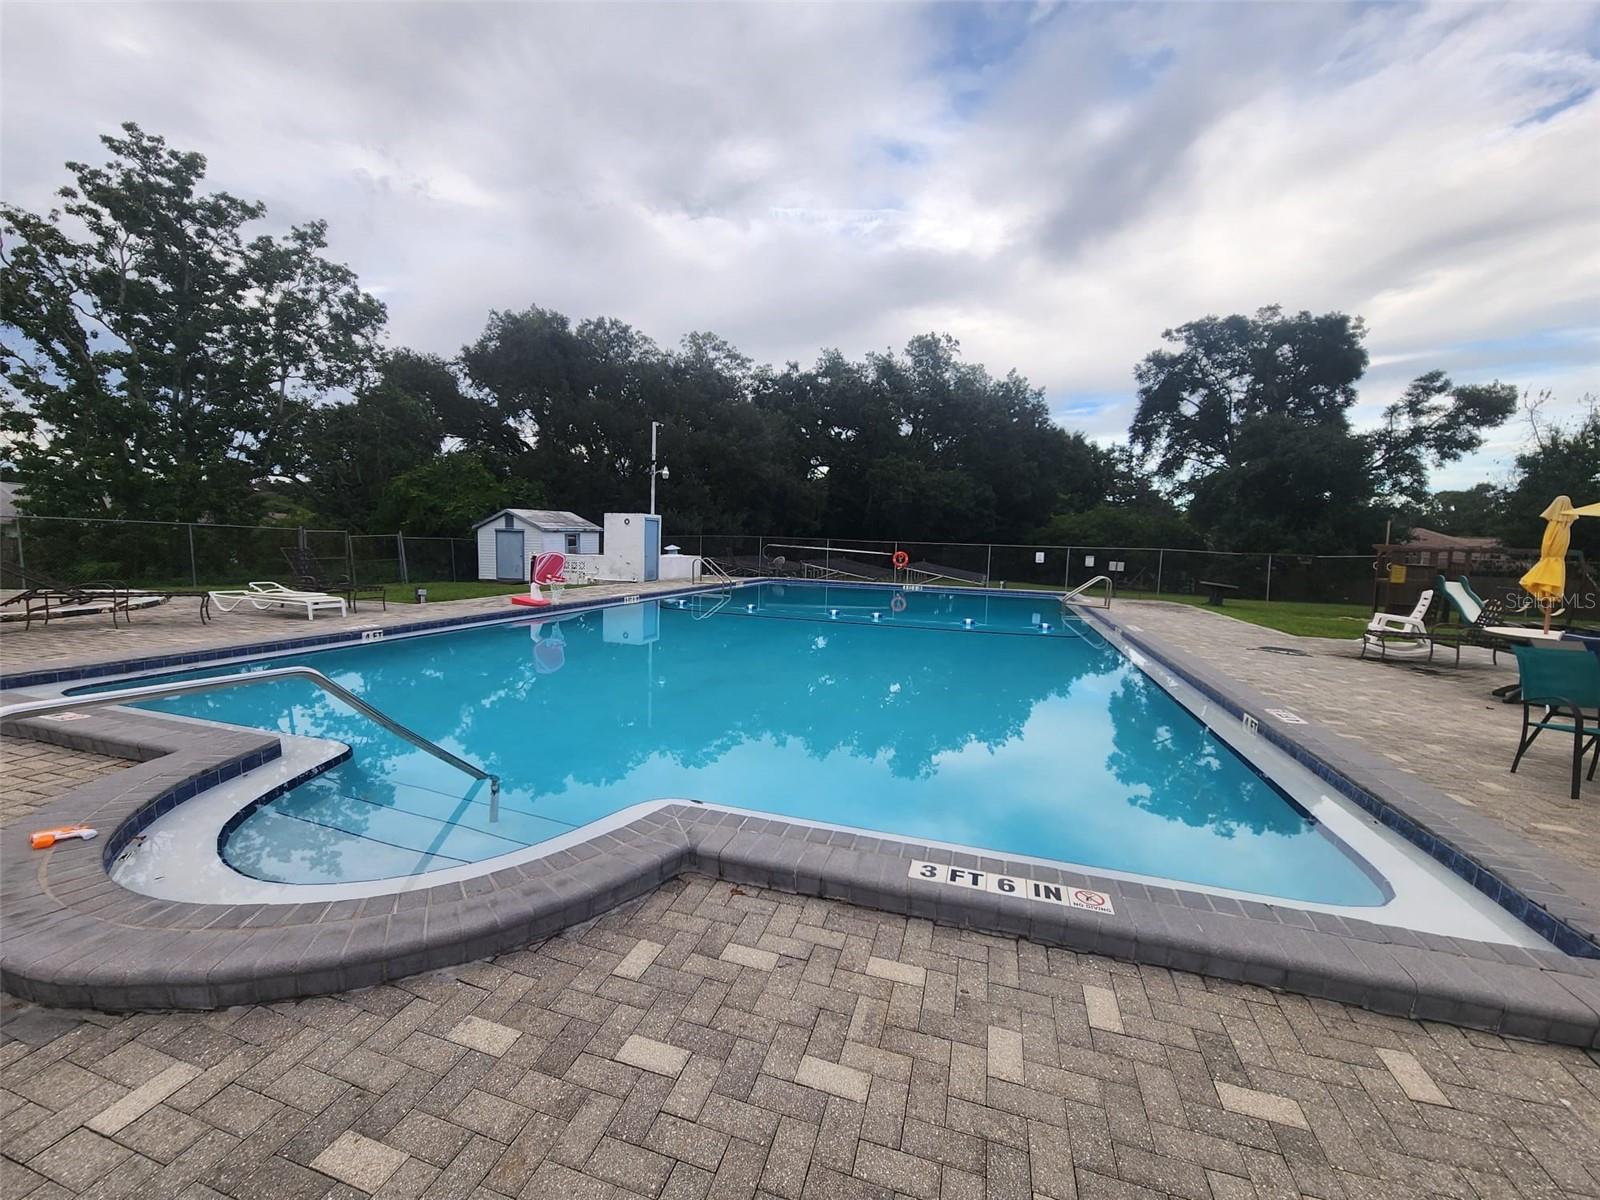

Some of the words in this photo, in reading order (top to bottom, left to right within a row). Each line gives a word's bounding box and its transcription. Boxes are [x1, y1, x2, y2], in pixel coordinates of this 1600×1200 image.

[920, 864, 937, 878] 3
[949, 868, 984, 887] FT
[997, 878, 1016, 893] 6
[1033, 883, 1063, 902] IN
[1085, 904, 1112, 913] DIVING
